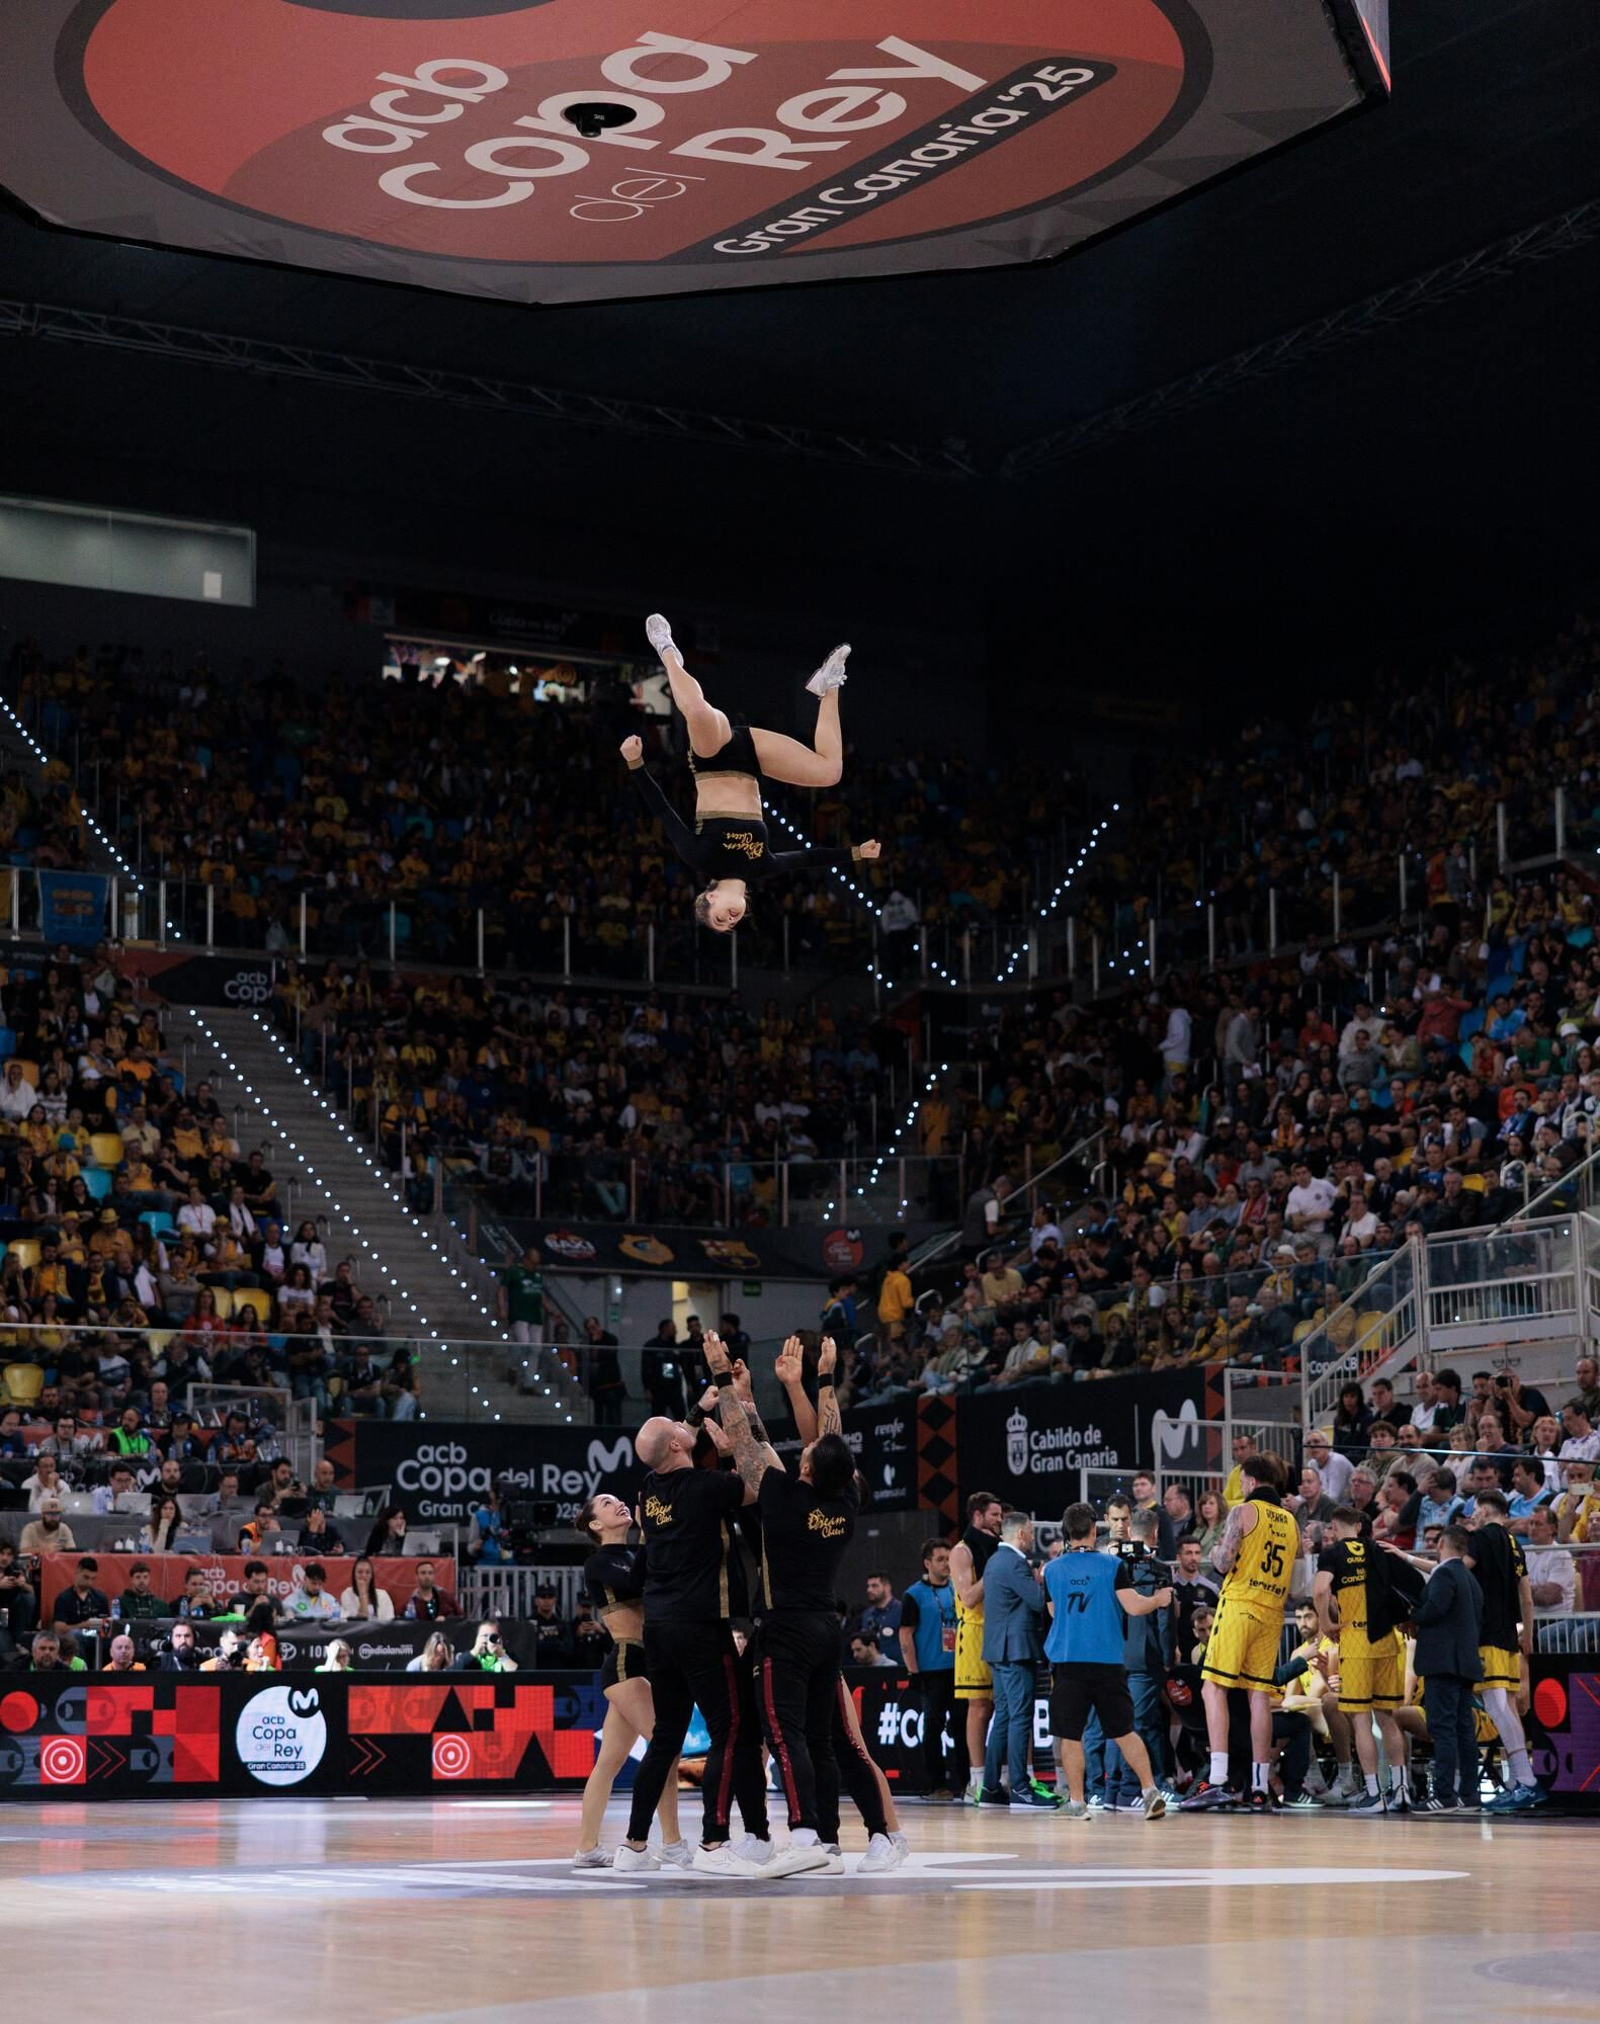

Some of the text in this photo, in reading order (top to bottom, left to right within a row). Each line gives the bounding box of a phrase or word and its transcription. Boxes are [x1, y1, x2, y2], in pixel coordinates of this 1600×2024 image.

[322, 58, 509, 154] acb
[378, 31, 759, 209] Copa
[569, 35, 988, 222] del Rey
[713, 206, 844, 254] Gran
[818, 105, 1030, 205] Canaria
[236, 970, 268, 986] acb
[874, 1416, 905, 1439] renfe
[1030, 1424, 1102, 1451] Cabildo de
[416, 1442, 467, 1464] acb
[1030, 1446, 1118, 1473] Gran Canaria
[396, 1459, 492, 1497] Copa
[541, 1464, 602, 1499] Rey
[418, 1500, 463, 1517] Gran
[808, 1510, 846, 1530] Dream
[1260, 1540, 1287, 1578] 35
[1070, 1578, 1087, 1586] acb
[1067, 1591, 1092, 1615] TV
[261, 1714, 286, 1725] acb
[252, 1725, 297, 1742] Copa
[274, 1743, 304, 1760] Rey
